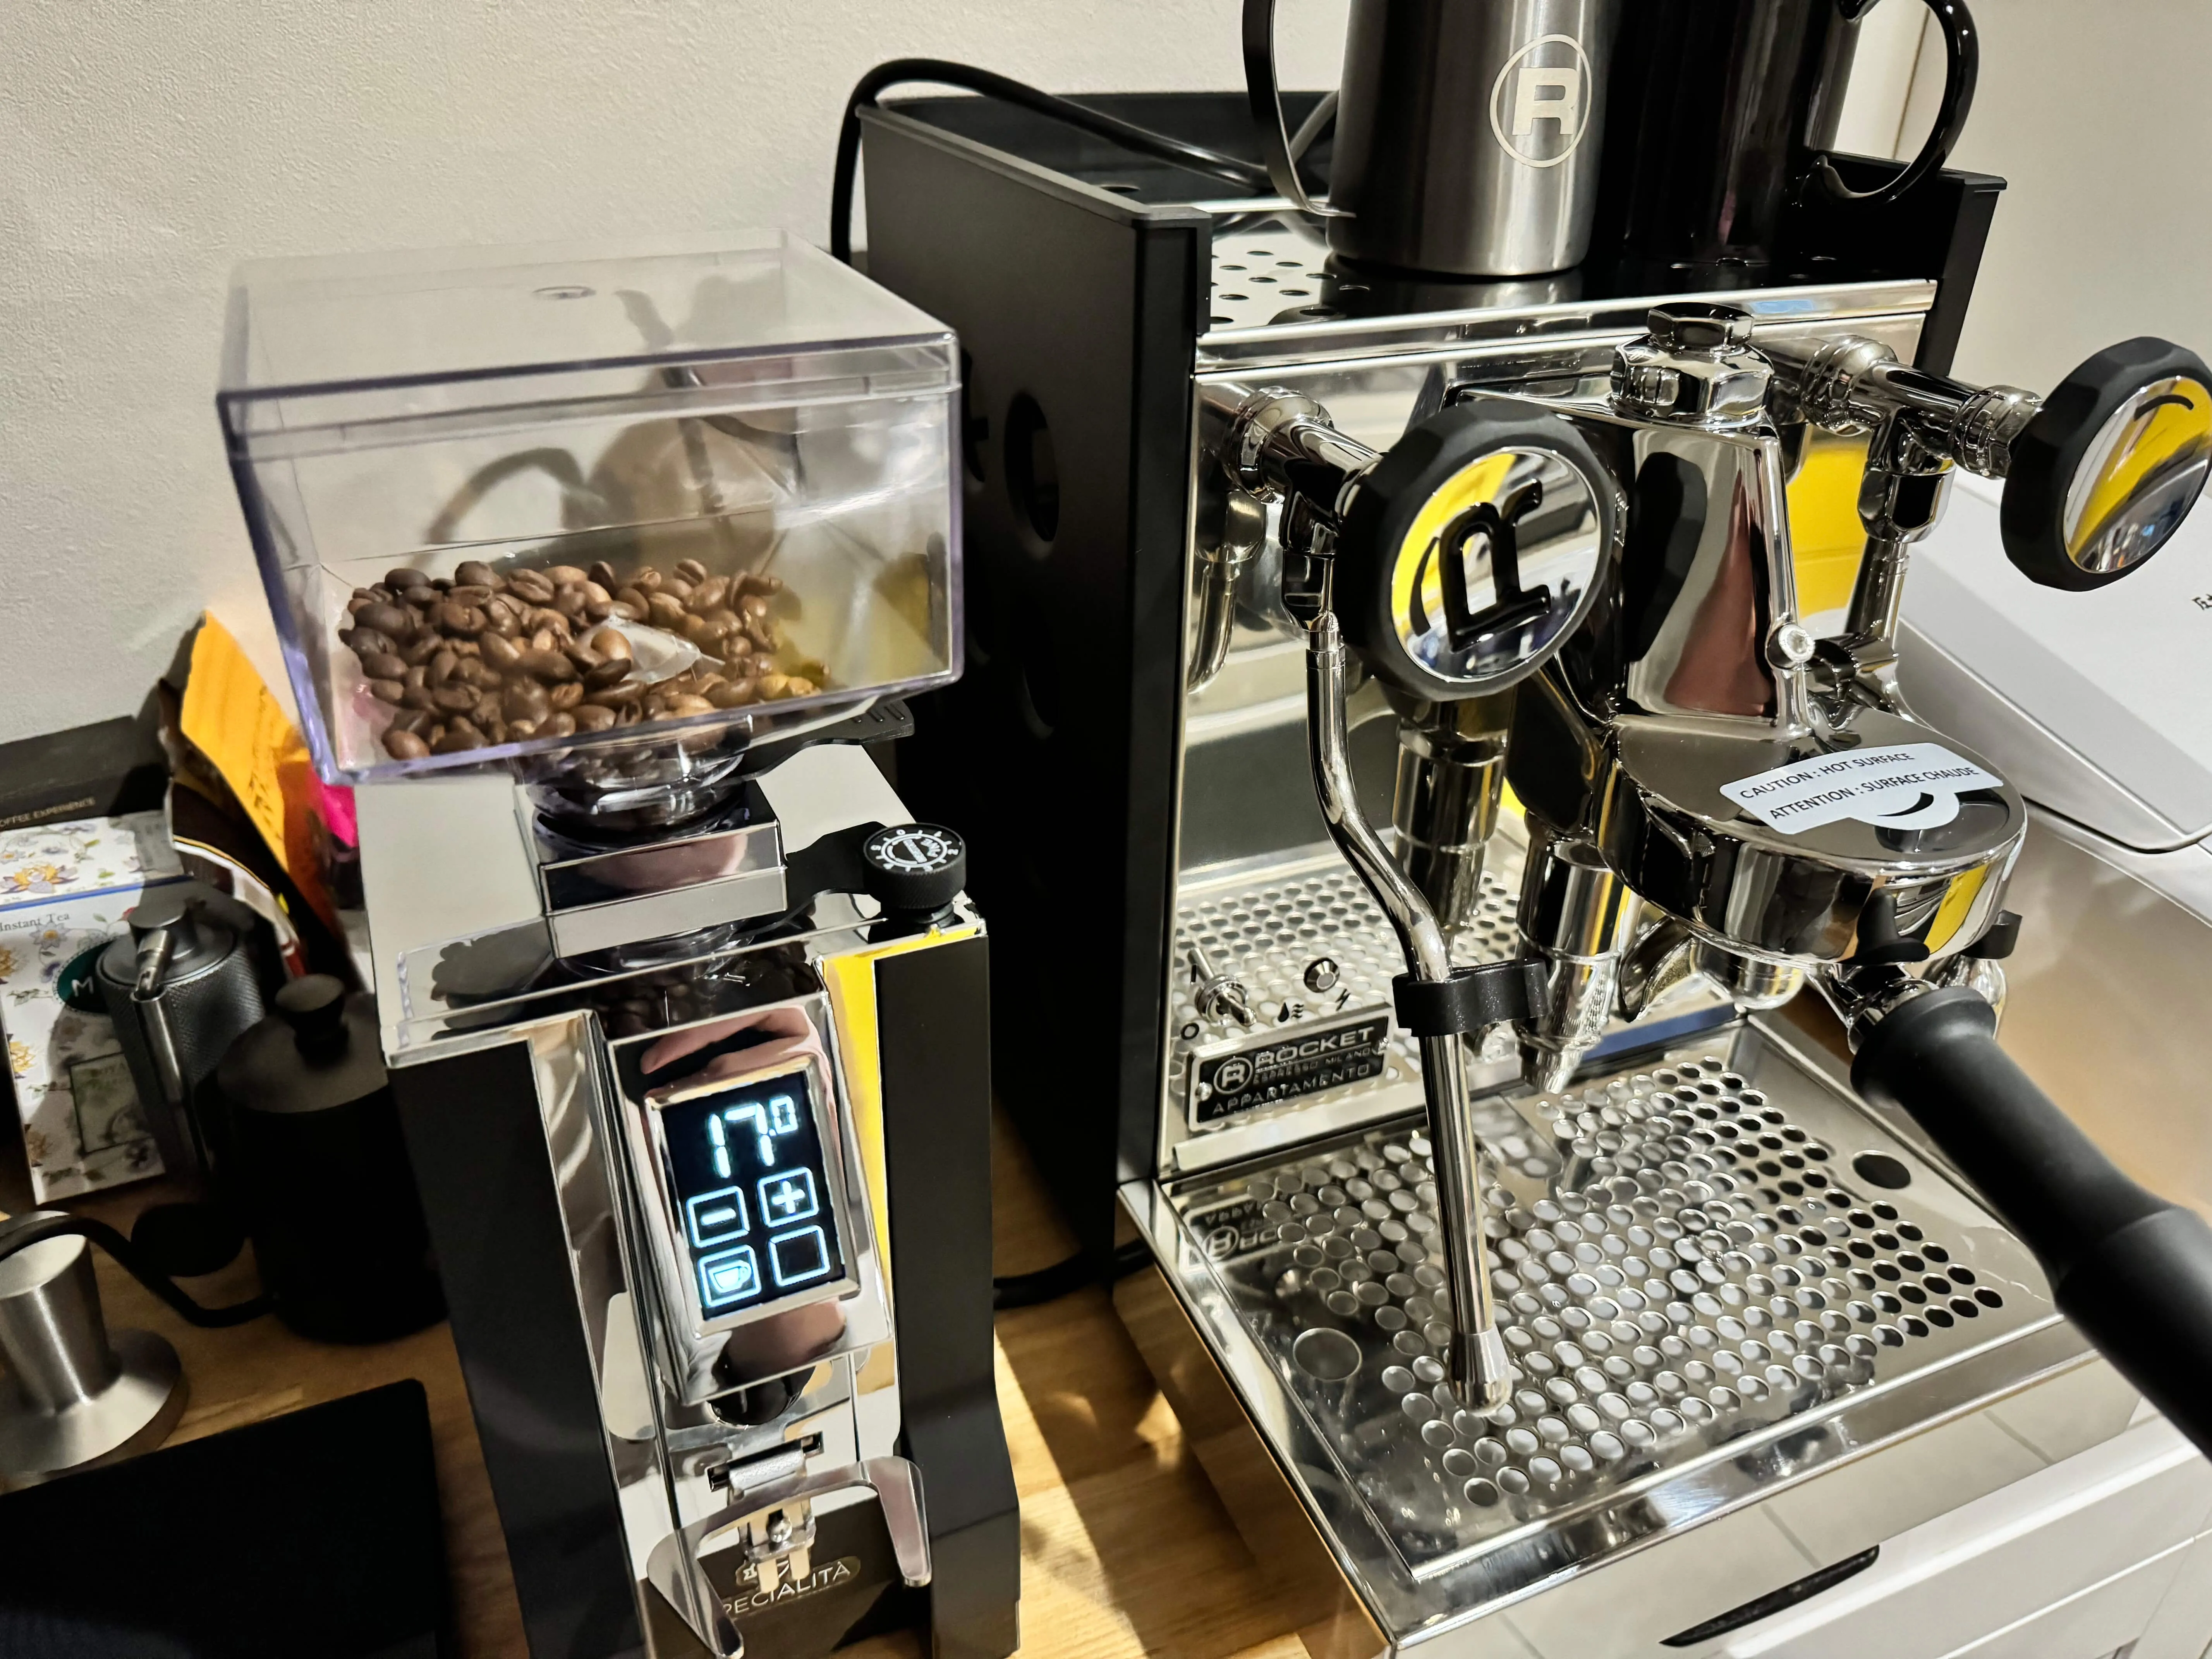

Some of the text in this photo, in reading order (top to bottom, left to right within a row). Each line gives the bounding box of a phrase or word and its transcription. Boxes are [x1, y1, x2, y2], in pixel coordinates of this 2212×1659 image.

[1512, 67, 1579, 135] R
[1740, 771, 1814, 798] CAUTION
[1819, 761, 1854, 775] HOT
[1852, 753, 1915, 767] SURFACE
[1770, 787, 1855, 819] ATTENTION
[1861, 773, 1925, 792] SURFACE
[1923, 767, 1980, 780] CHAUDE
[0, 913, 69, 931] Instant Tea
[1255, 1027, 1374, 1068] ROCKET
[1212, 1064, 1370, 1115] APPARTAMENTO
[723, 1561, 850, 1615] PECIALITÀ
